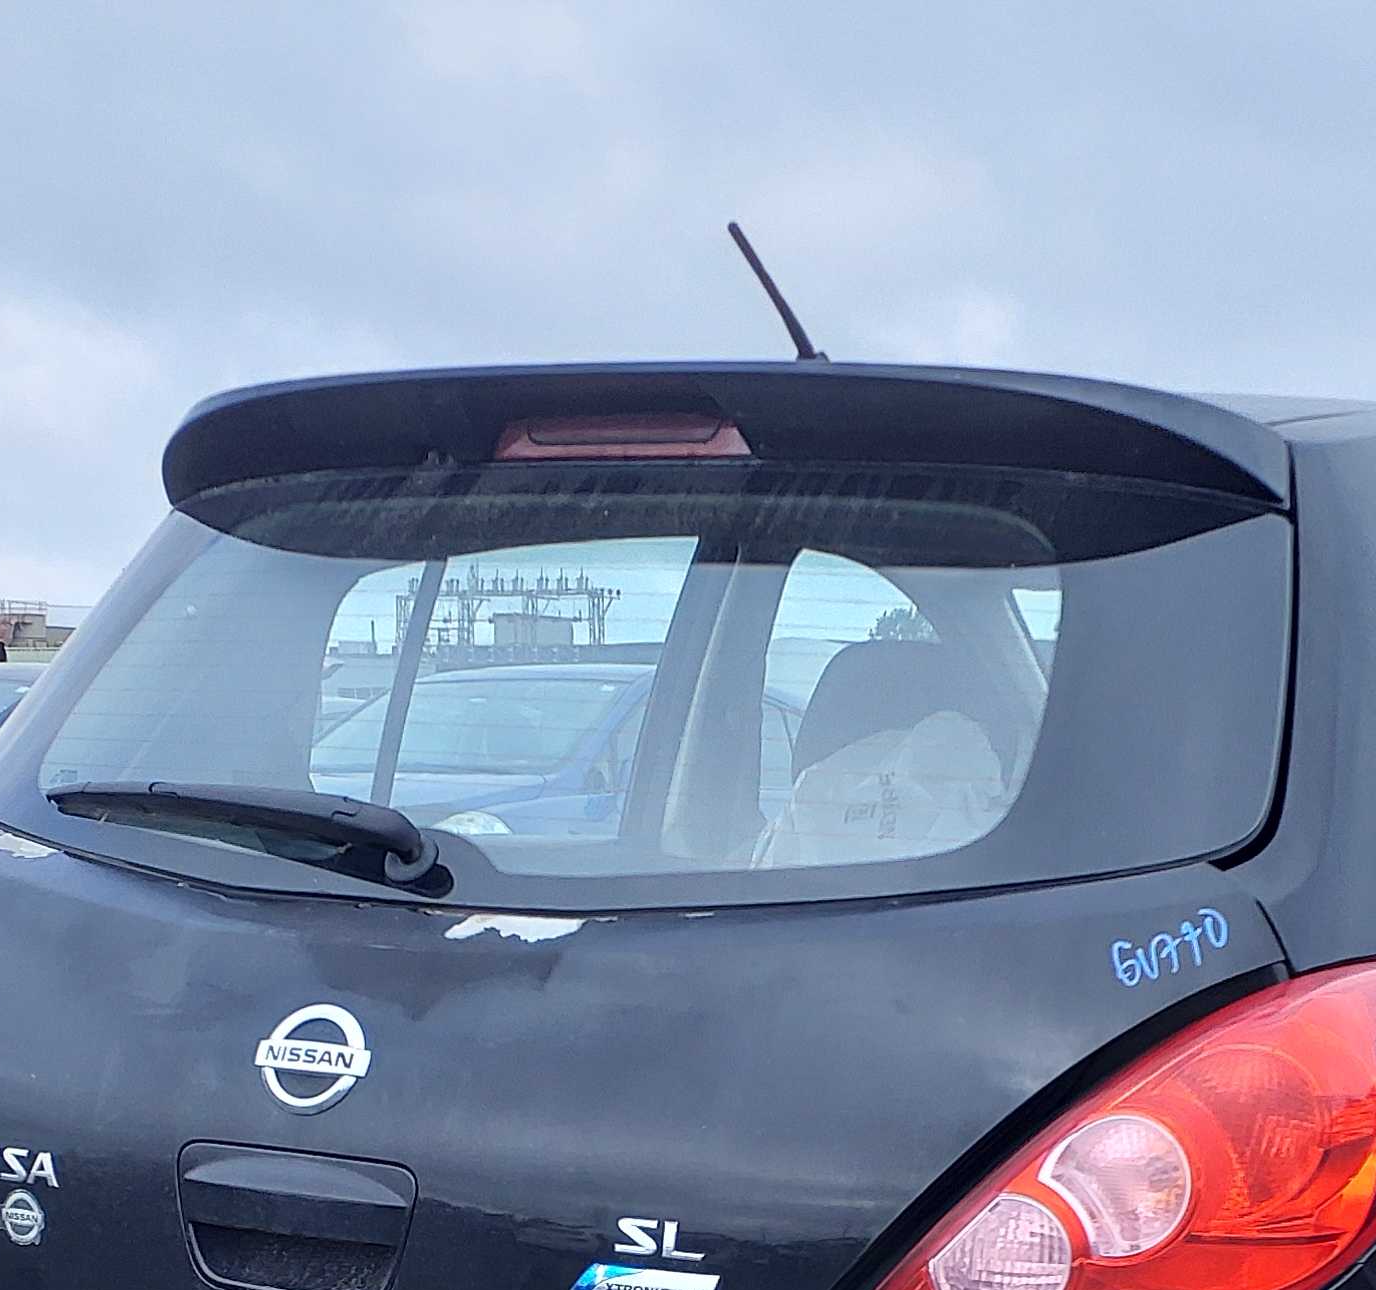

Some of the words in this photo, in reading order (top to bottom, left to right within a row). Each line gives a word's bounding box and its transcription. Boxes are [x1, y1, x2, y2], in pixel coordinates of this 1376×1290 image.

[265, 1045, 354, 1069] NISSAN
[4, 1210, 39, 1225] NISSAN
[614, 1217, 706, 1261] SL
